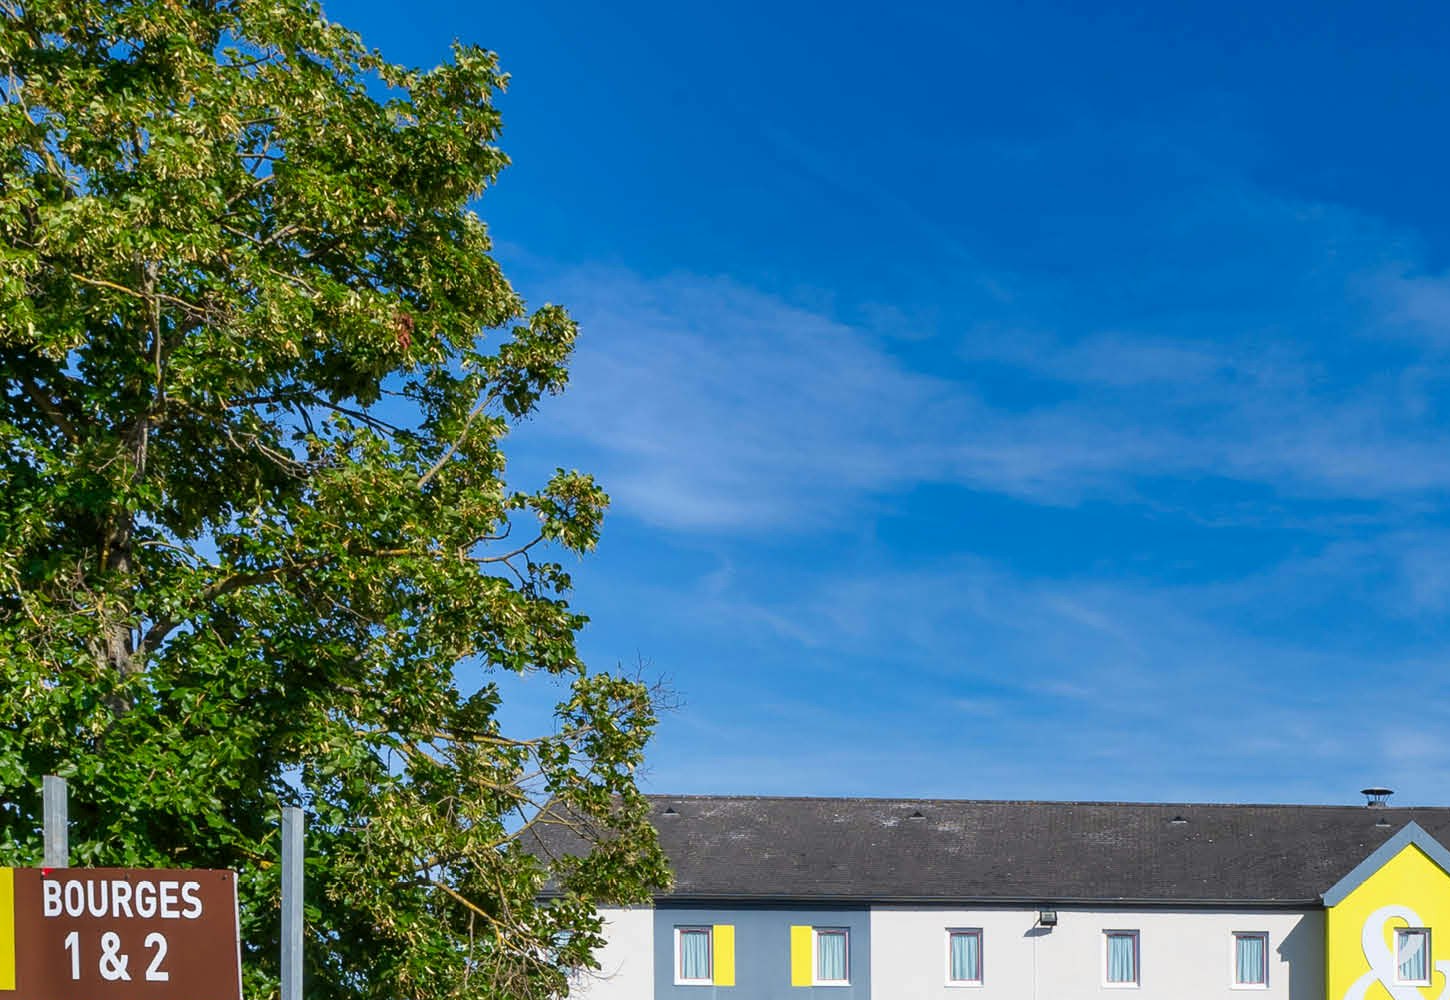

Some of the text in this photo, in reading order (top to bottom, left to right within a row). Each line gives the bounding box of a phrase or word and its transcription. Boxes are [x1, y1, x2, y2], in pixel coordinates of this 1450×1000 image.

[43, 880, 203, 919] BOURGES
[64, 932, 169, 981] 1 & 2
